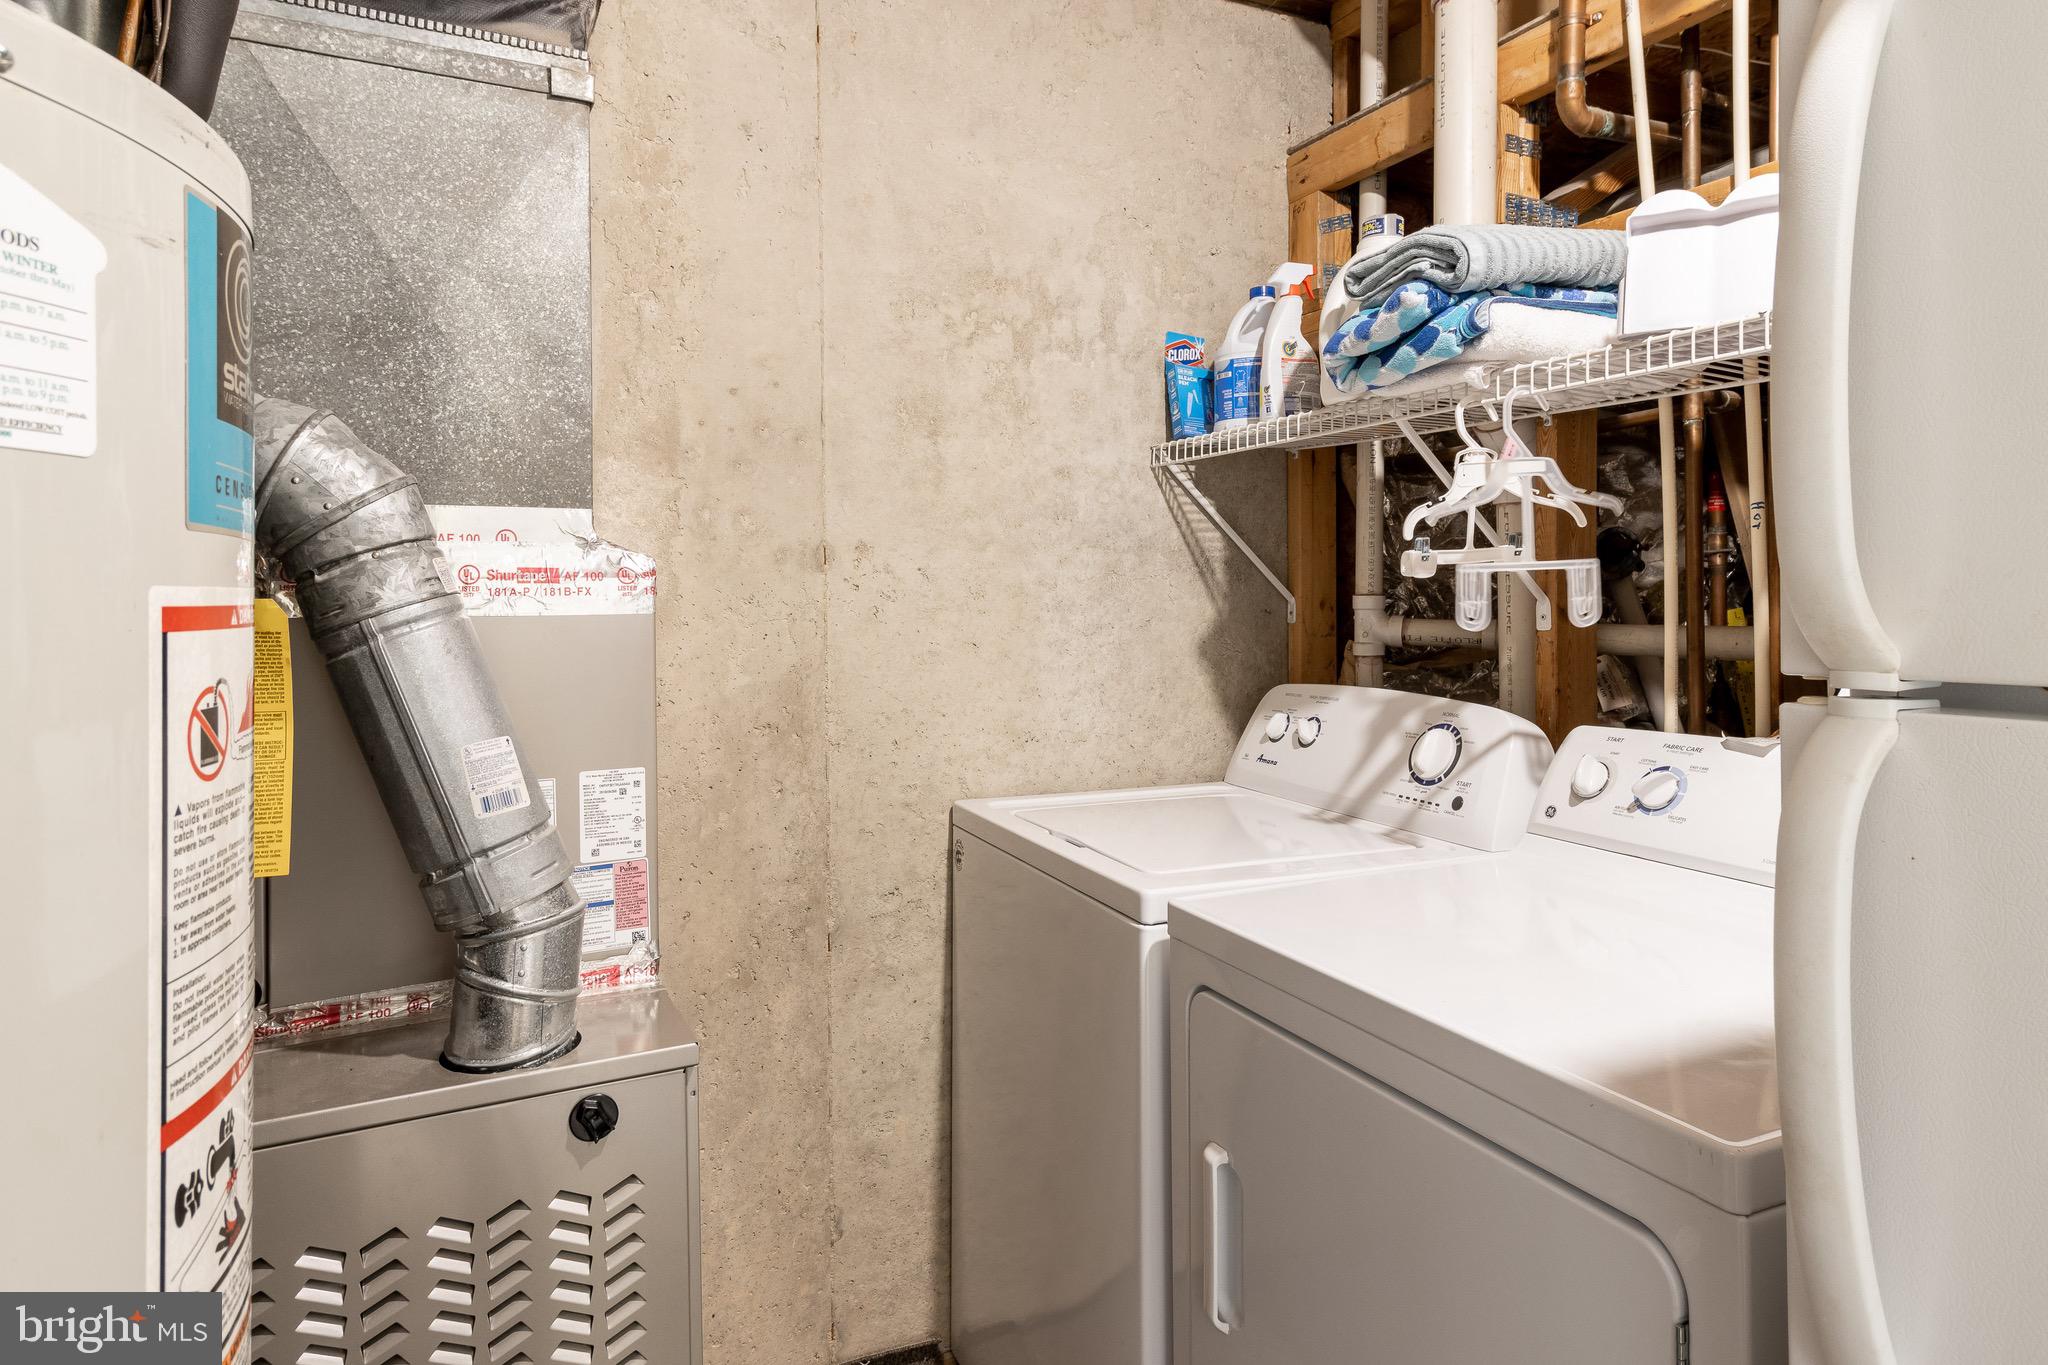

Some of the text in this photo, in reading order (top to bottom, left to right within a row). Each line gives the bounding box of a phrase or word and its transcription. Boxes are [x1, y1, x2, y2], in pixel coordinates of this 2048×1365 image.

[0, 228, 40, 252] ODS
[2, 251, 58, 276] WINTER
[1167, 349, 1201, 362] CLOROX
[564, 571, 579, 582] AF
[584, 571, 605, 582] 100
[543, 586, 592, 597] 181B-FX
[1662, 743, 1687, 752] FABRIC
[1685, 746, 1705, 754] CARE
[1255, 753, 1279, 766] Amana
[1456, 780, 1473, 788] START
[187, 799, 210, 813] Vapors
[173, 814, 200, 831] liquids
[203, 807, 213, 819] will
[173, 829, 194, 844] catch
[173, 841, 197, 857] severe
[173, 872, 202, 891] products
[173, 919, 189, 932] Keep
